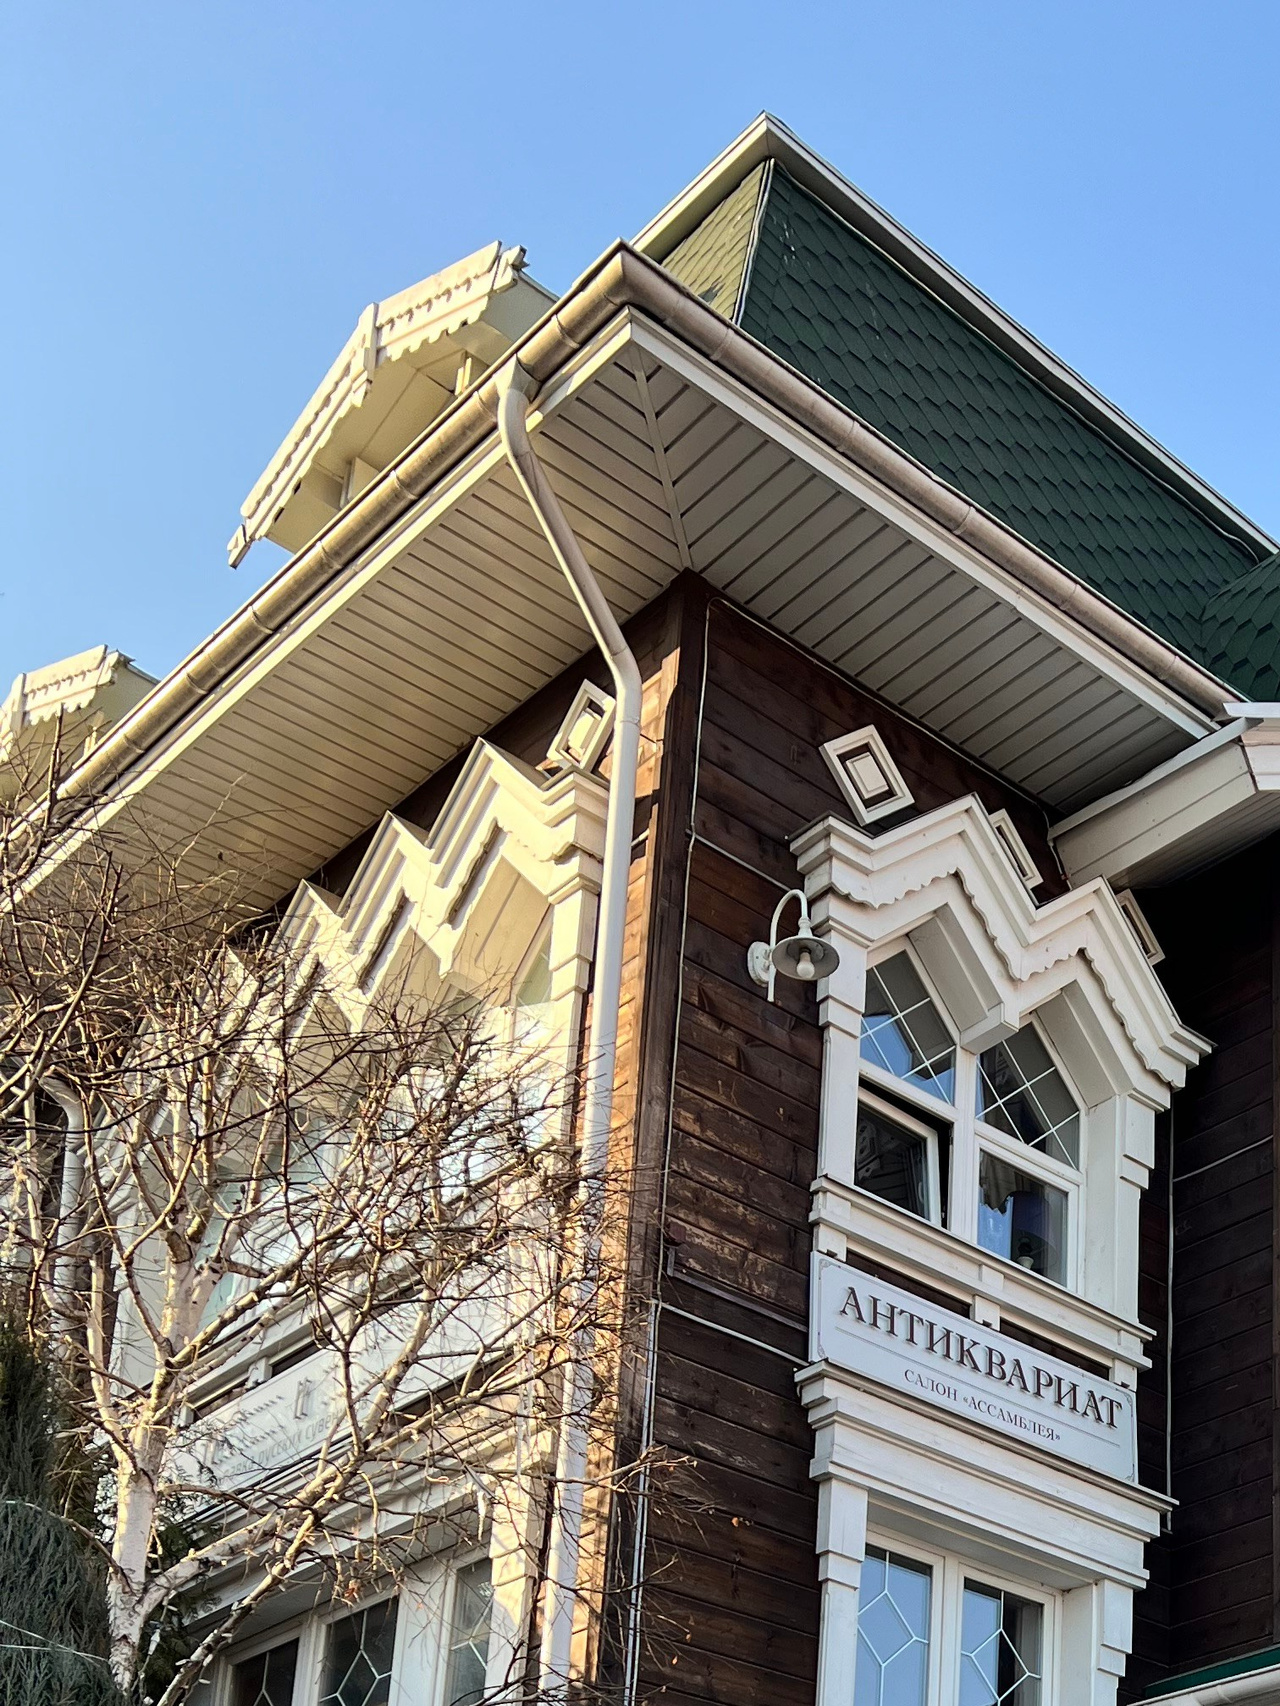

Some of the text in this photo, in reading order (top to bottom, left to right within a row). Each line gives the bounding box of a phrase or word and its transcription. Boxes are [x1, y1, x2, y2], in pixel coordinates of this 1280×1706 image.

[839, 1286, 1124, 1429] АНТИКВАРИАТ
[904, 1368, 1061, 1441] САЛОН «АССАМБЛЕЯ»
